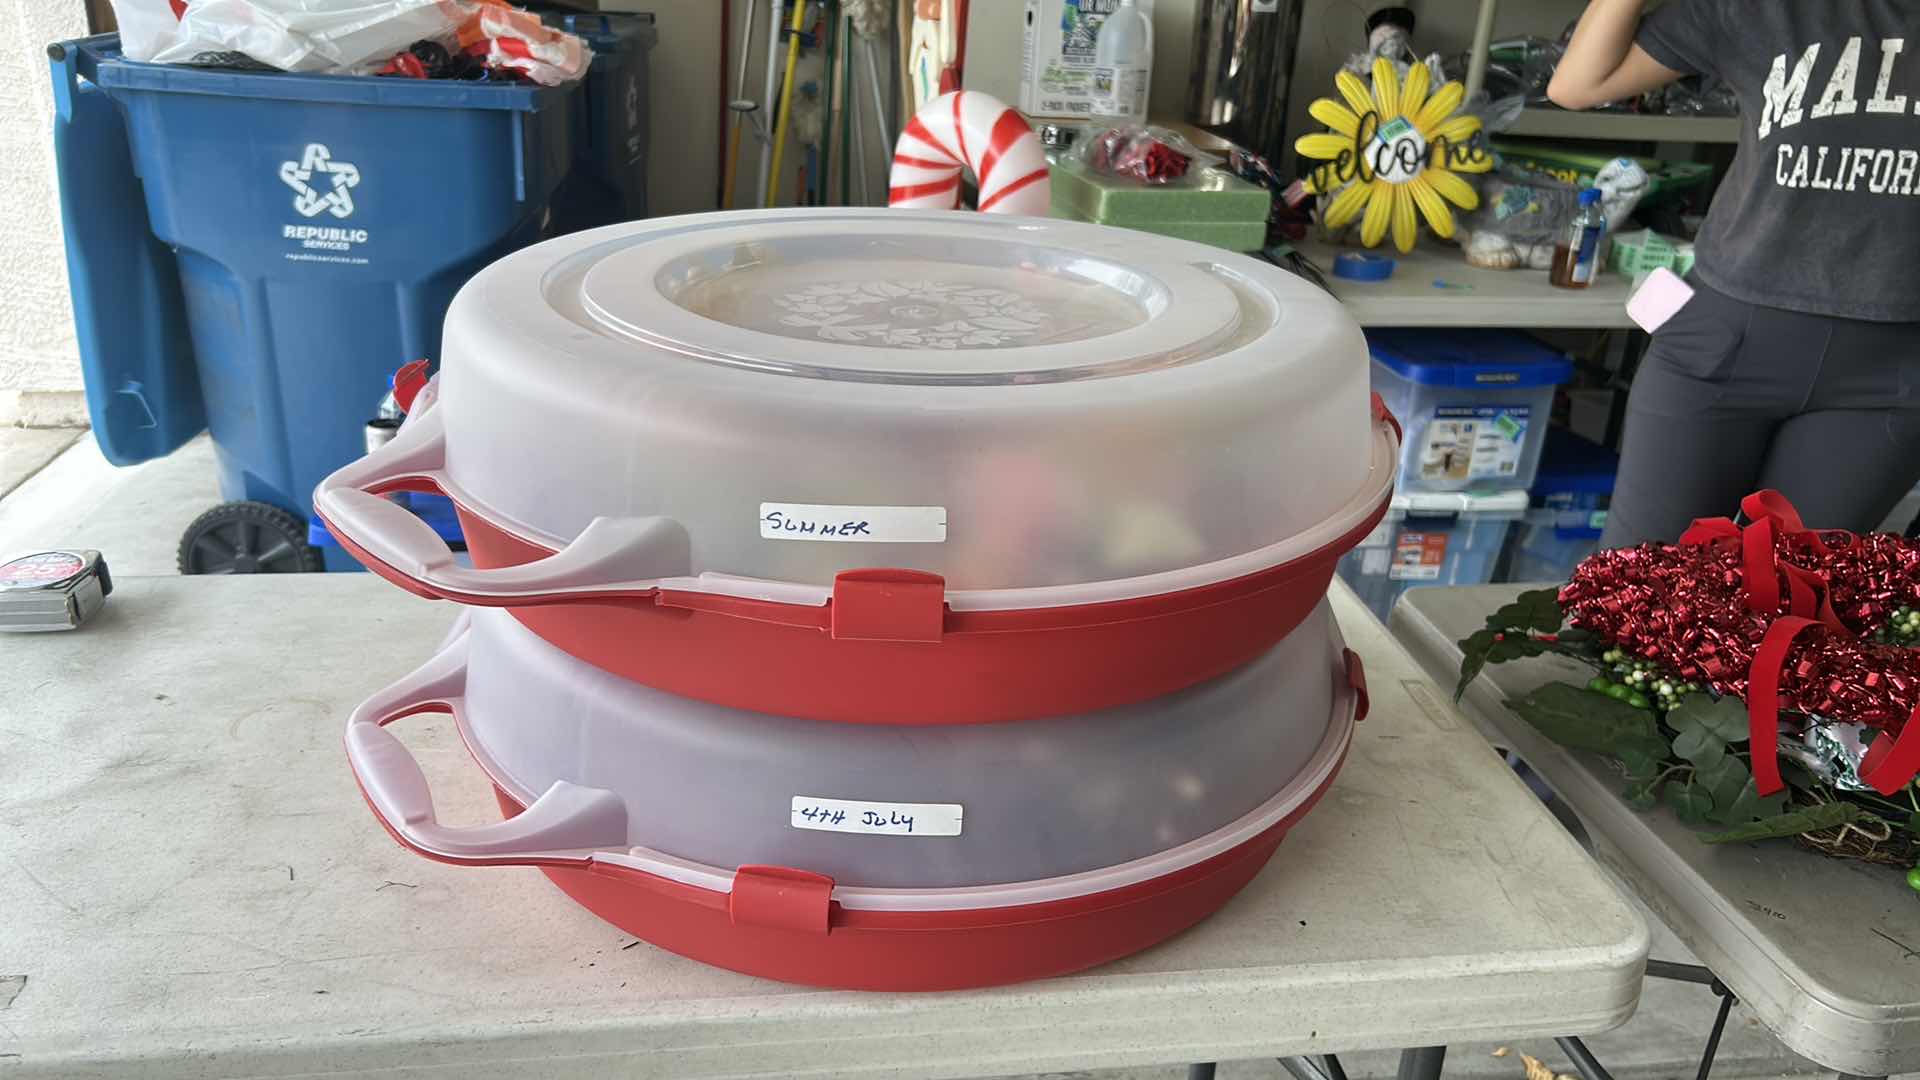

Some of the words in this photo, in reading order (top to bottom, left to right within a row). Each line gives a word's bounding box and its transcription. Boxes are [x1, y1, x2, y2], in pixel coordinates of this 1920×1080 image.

[1758, 36, 1920, 141] MAL
[1308, 111, 1485, 196] welcome
[1776, 143, 1920, 195] CALIFOR
[283, 224, 368, 243] REPUBLIC
[303, 240, 350, 251] SERVICES
[285, 252, 369, 264] republicservices.com
[766, 511, 871, 536] SUMMER
[801, 806, 846, 825] 4TH
